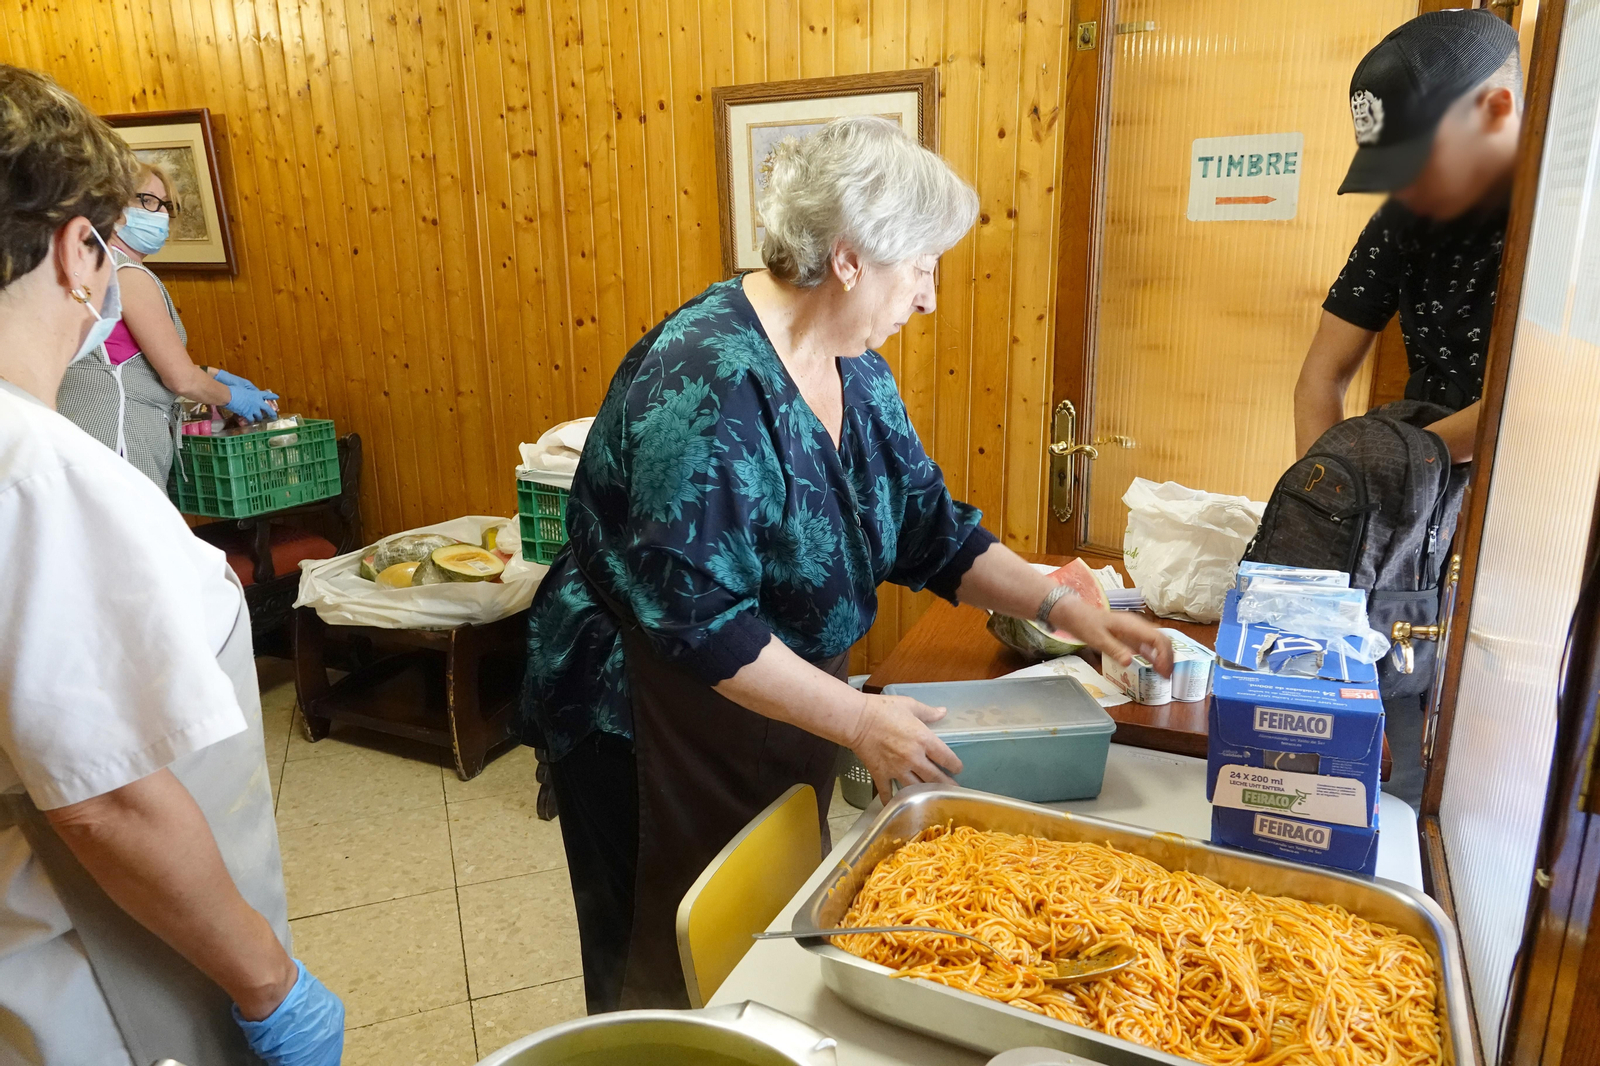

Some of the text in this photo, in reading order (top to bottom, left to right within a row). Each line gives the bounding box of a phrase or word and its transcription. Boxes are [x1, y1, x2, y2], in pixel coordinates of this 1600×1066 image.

[1198, 152, 1297, 178] TIMBRE
[1230, 771, 1241, 779] 24
[1251, 774, 1268, 783] 200
